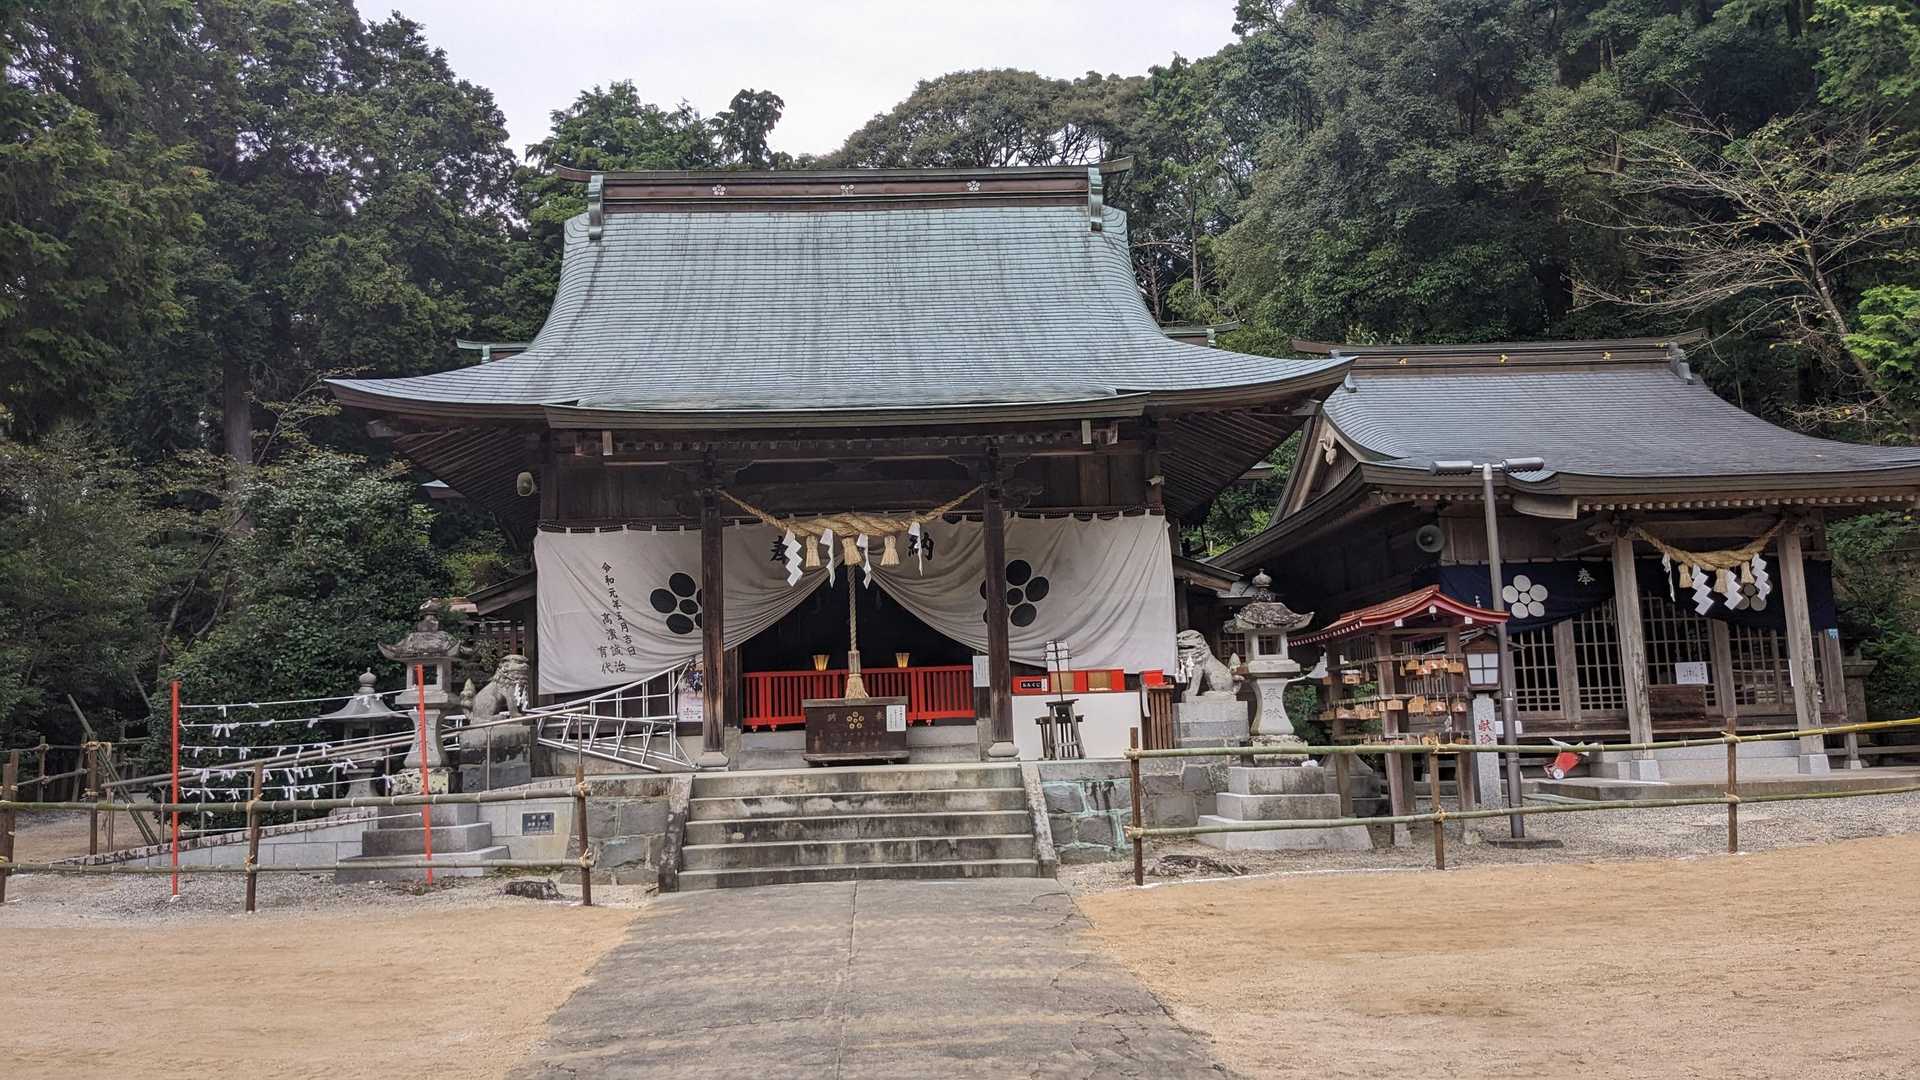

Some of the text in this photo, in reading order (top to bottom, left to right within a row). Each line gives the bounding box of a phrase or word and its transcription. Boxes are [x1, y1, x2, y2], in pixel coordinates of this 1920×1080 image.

[1577, 567, 1595, 585] 奉
[601, 561, 637, 657] 令和元年五月吉日
